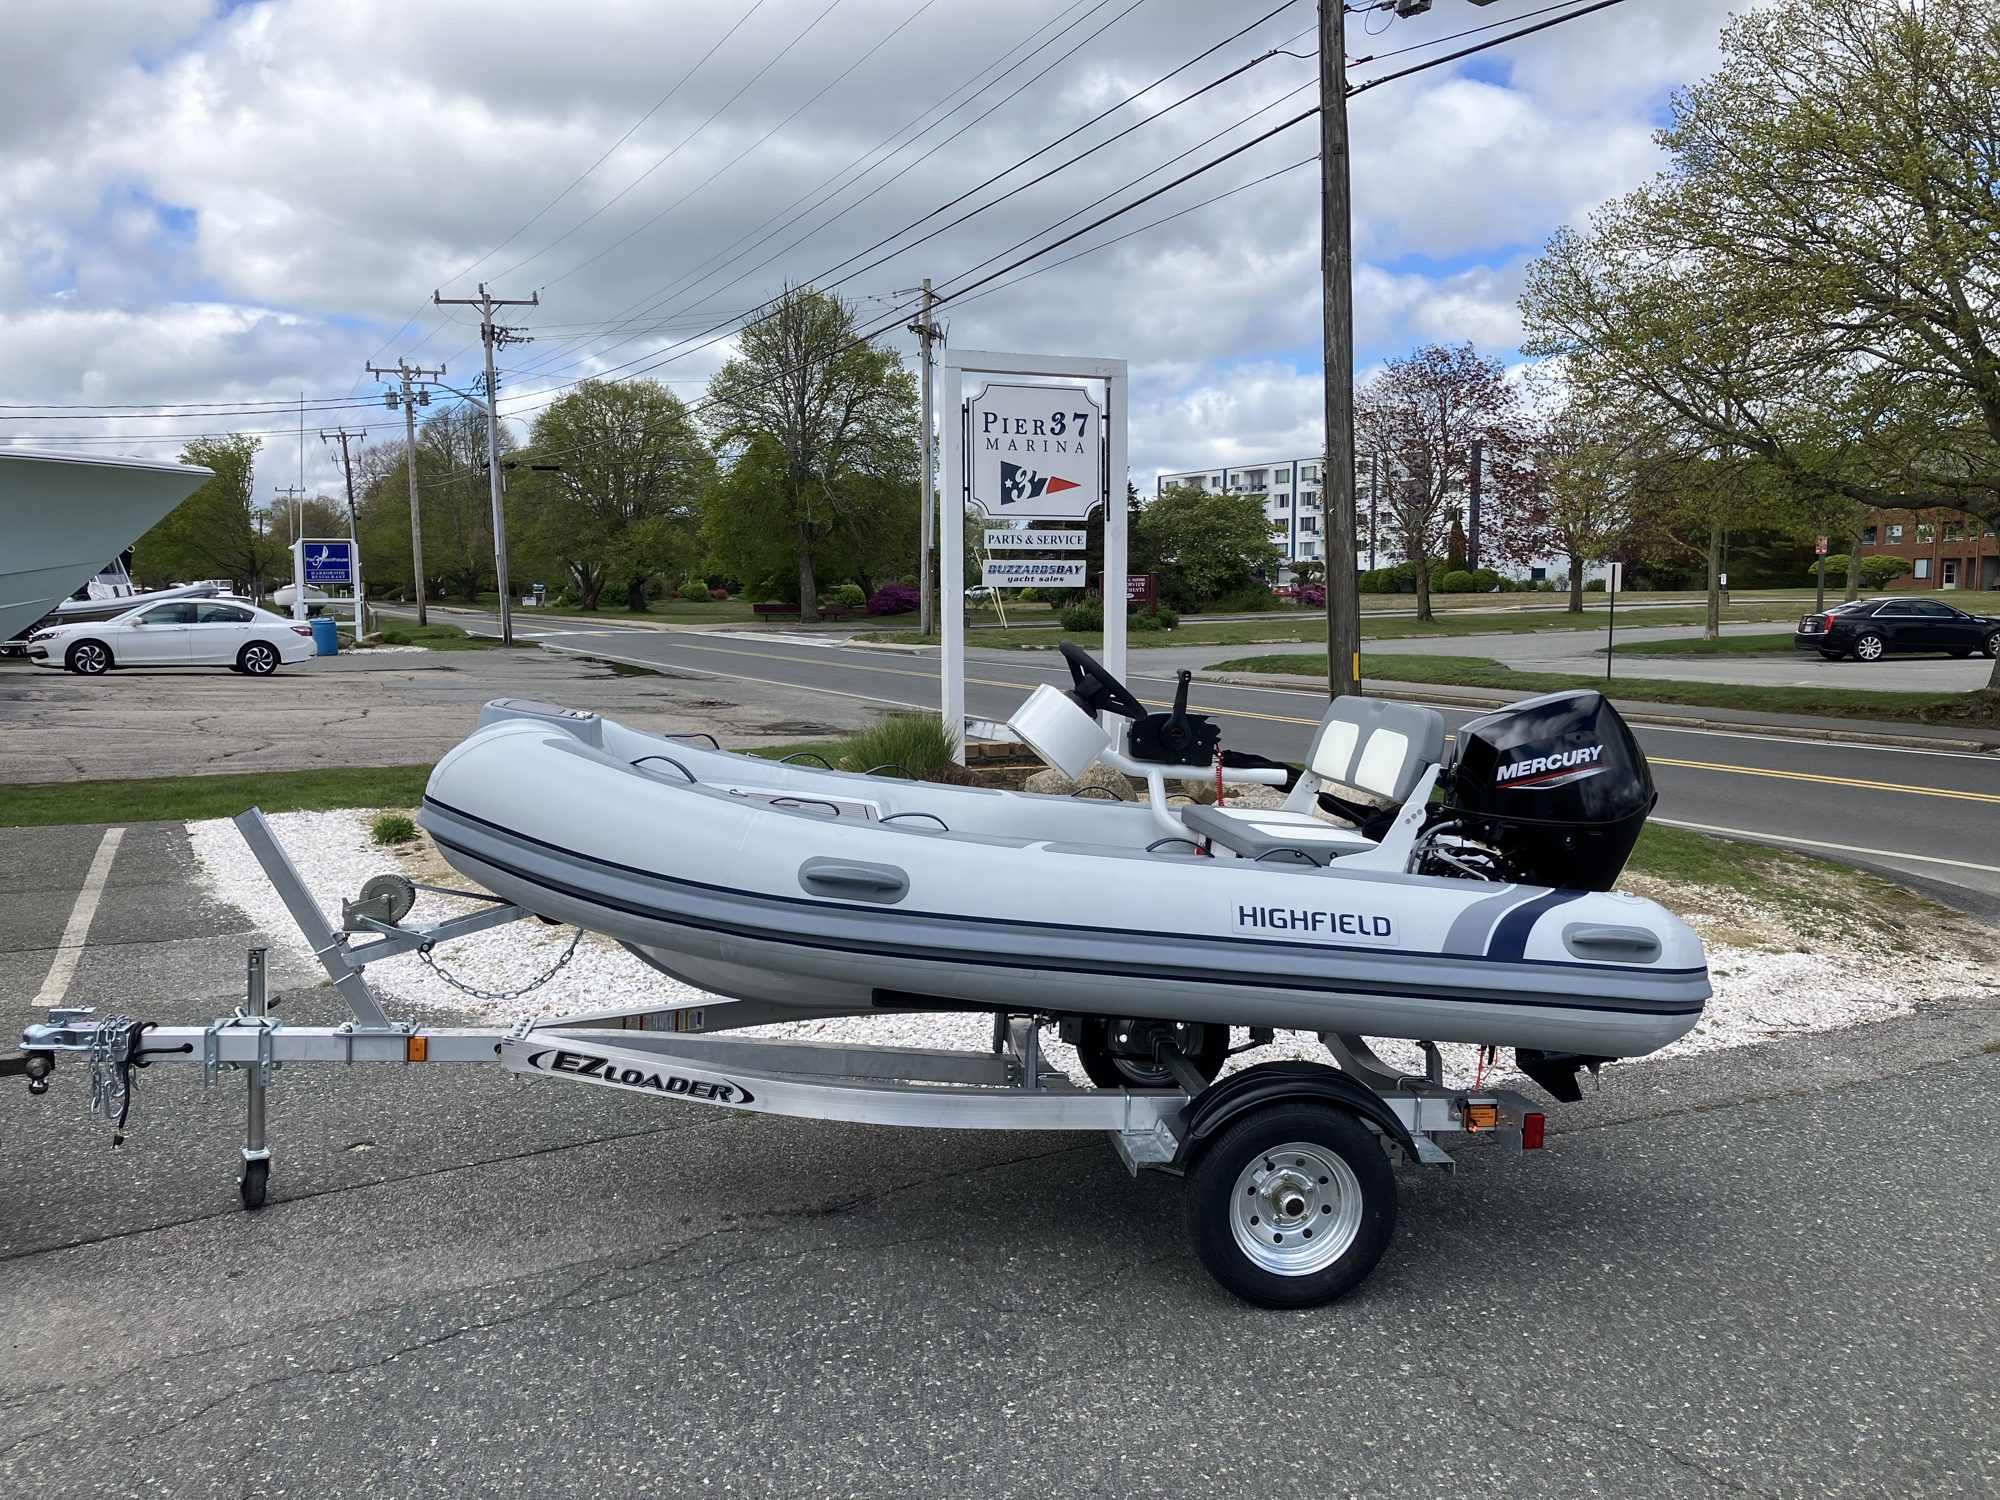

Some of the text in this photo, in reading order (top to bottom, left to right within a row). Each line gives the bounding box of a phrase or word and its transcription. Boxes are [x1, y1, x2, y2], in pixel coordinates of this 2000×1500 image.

[985, 437, 1085, 454] MARINA
[987, 533, 1084, 546] PARTS & SERVICE
[1007, 575, 1065, 584] yacht sales
[1496, 744, 1604, 782] MERCURY
[1238, 905, 1392, 938] HIGHFIELD
